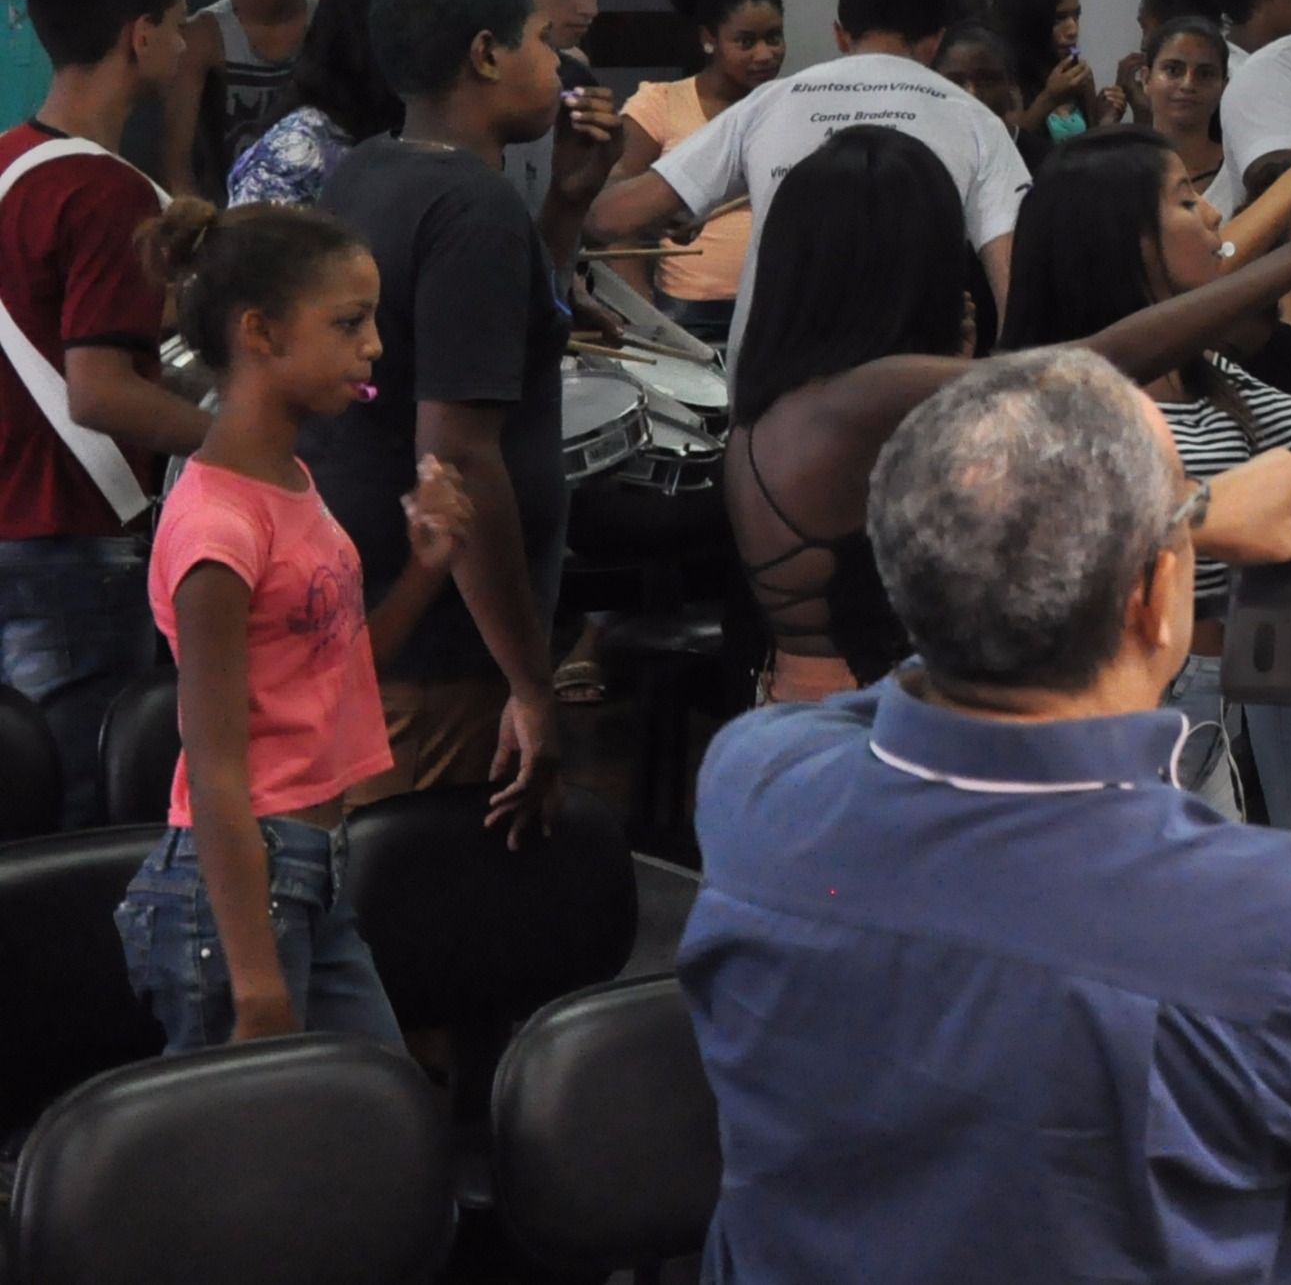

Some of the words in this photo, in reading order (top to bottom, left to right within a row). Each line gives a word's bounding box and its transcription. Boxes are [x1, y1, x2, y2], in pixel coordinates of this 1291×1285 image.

[791, 81, 948, 100] #JuntosComVinicius
[810, 111, 851, 123] Conta
[854, 109, 917, 122] Bradesco
